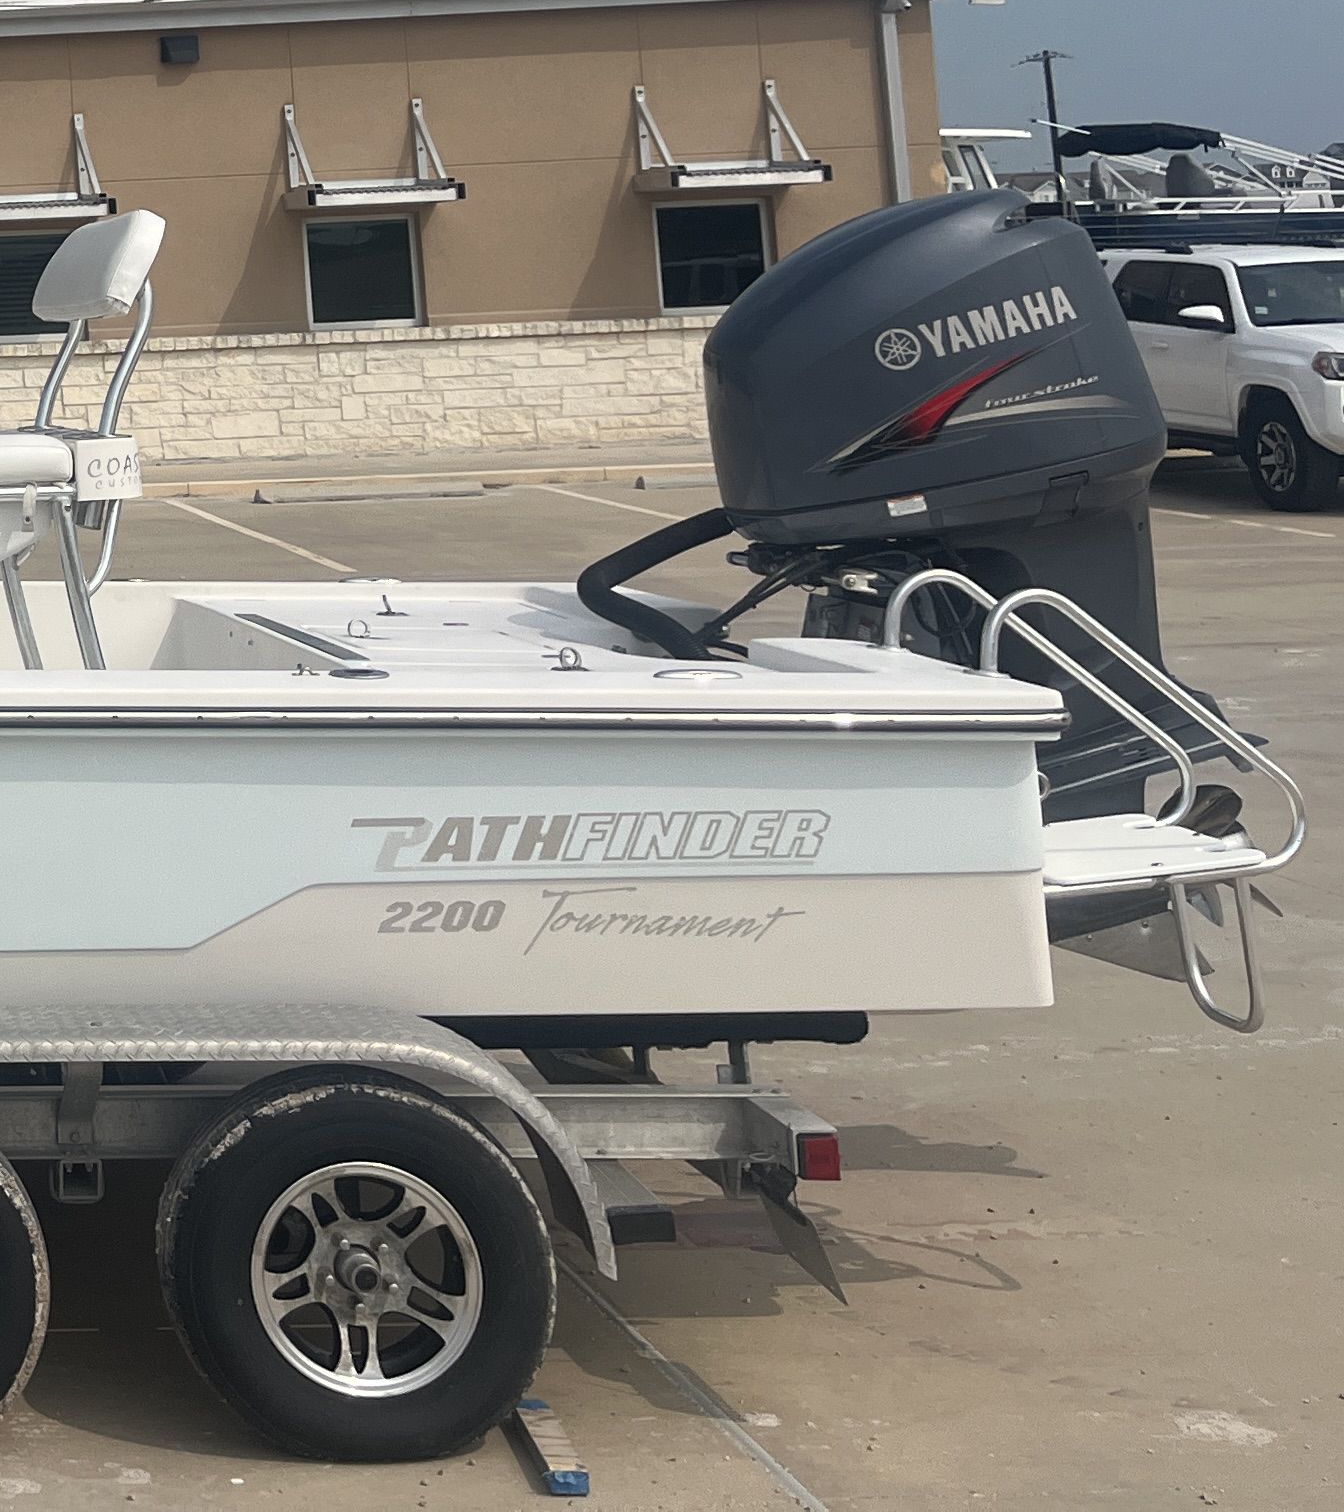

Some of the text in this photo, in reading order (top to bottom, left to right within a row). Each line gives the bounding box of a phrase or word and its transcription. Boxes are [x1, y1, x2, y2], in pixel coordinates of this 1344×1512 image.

[917, 286, 1078, 358] YAMAHA
[351, 808, 832, 873] PATHFINDER
[378, 887, 807, 956] 2200 Tournament
